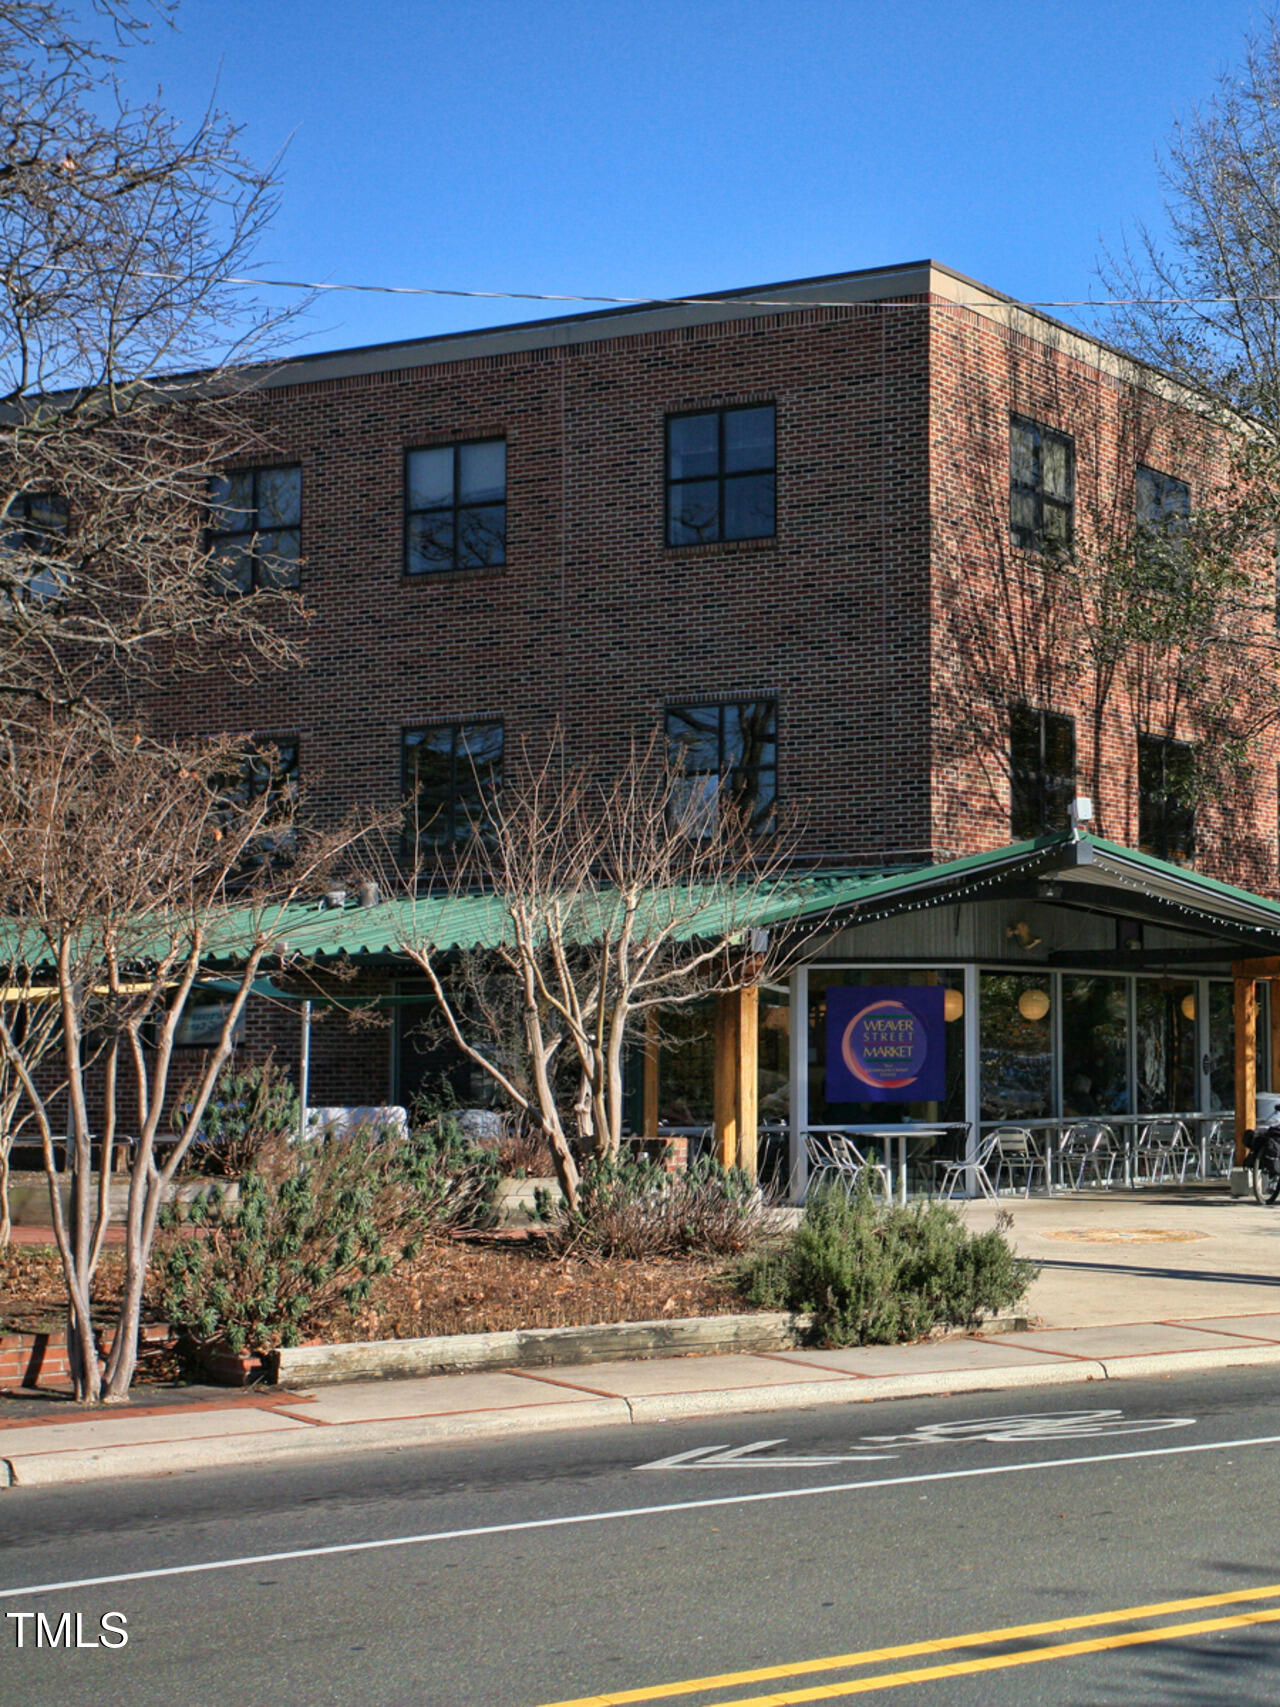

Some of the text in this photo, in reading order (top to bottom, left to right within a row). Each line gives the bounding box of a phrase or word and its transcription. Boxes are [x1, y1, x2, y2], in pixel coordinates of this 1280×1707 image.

[863, 1020, 914, 1031] WEAVER
[863, 1032, 913, 1041] STREET
[863, 1046, 913, 1057] MARKET
